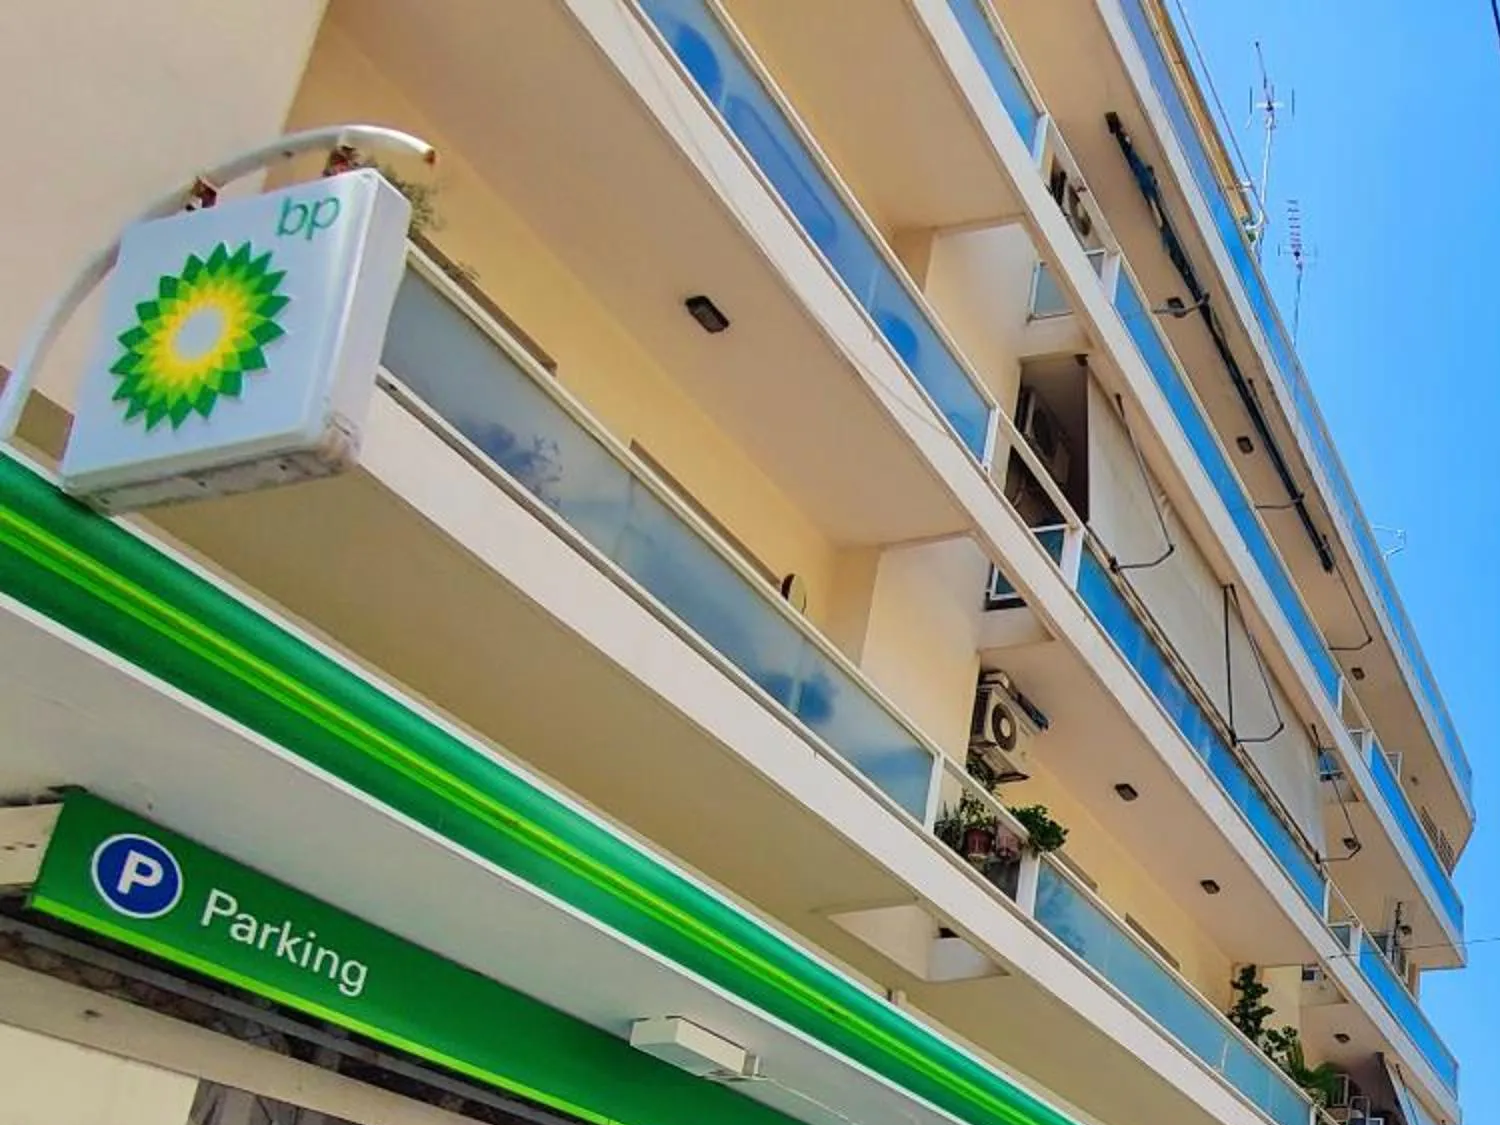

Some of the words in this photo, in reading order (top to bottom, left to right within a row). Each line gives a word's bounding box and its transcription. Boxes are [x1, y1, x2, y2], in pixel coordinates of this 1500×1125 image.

[276, 196, 340, 240] bp
[117, 849, 164, 893] P
[201, 887, 369, 997] Parking
